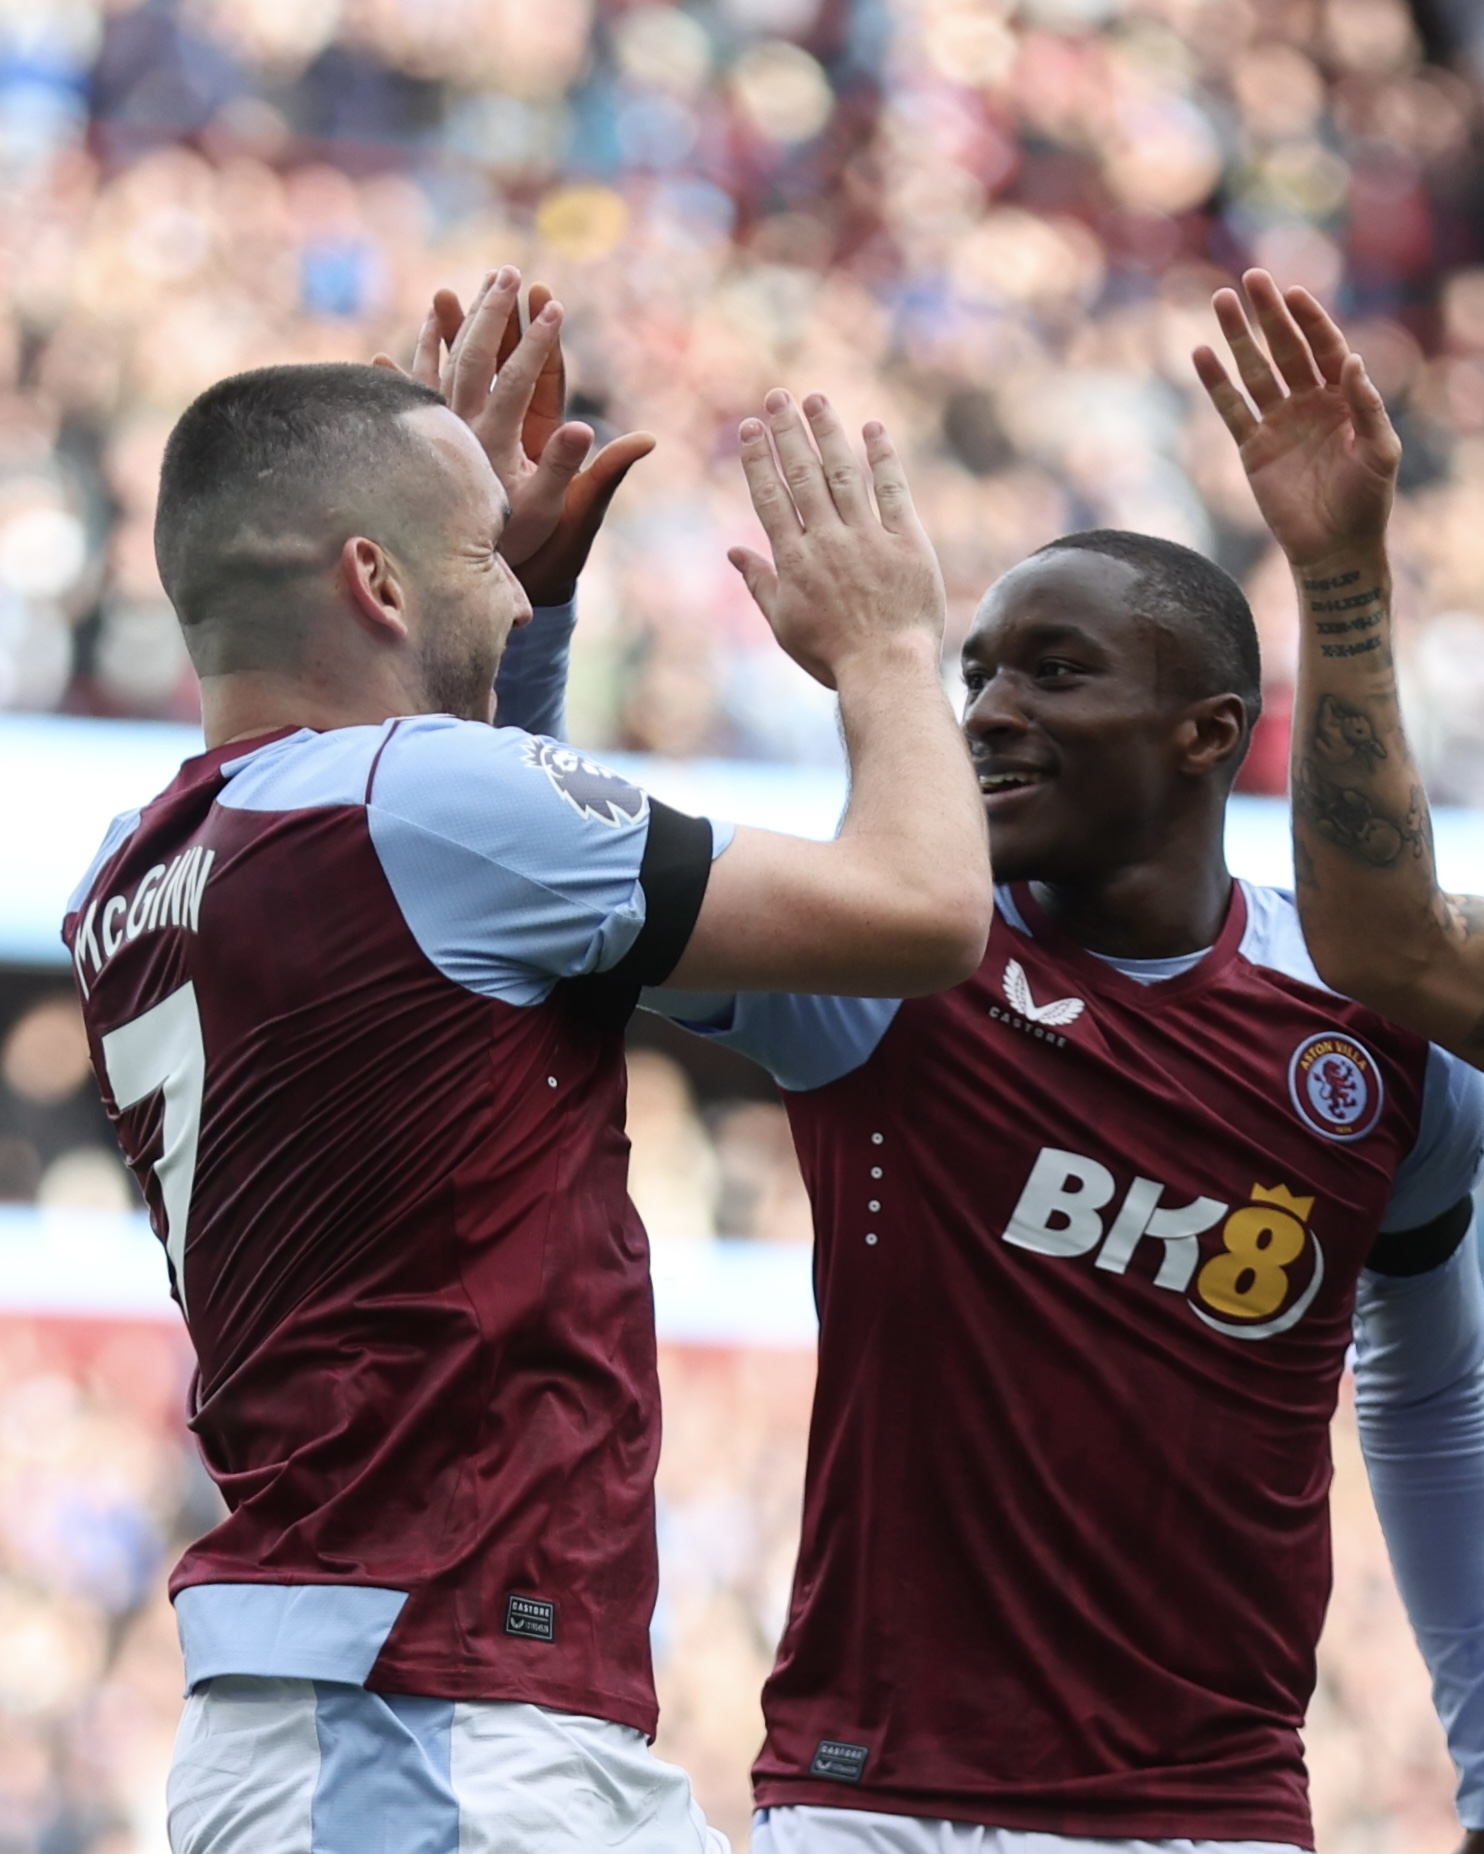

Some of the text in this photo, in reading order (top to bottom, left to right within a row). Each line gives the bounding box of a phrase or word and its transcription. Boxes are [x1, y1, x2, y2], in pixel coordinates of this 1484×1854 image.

[988, 1006, 1067, 1048] CASTORE
[1300, 1040, 1368, 1071] ASTON VILLA
[102, 978, 206, 1324] 7
[1002, 1147, 1306, 1319] BK8
[512, 1601, 550, 1618] CASTORE
